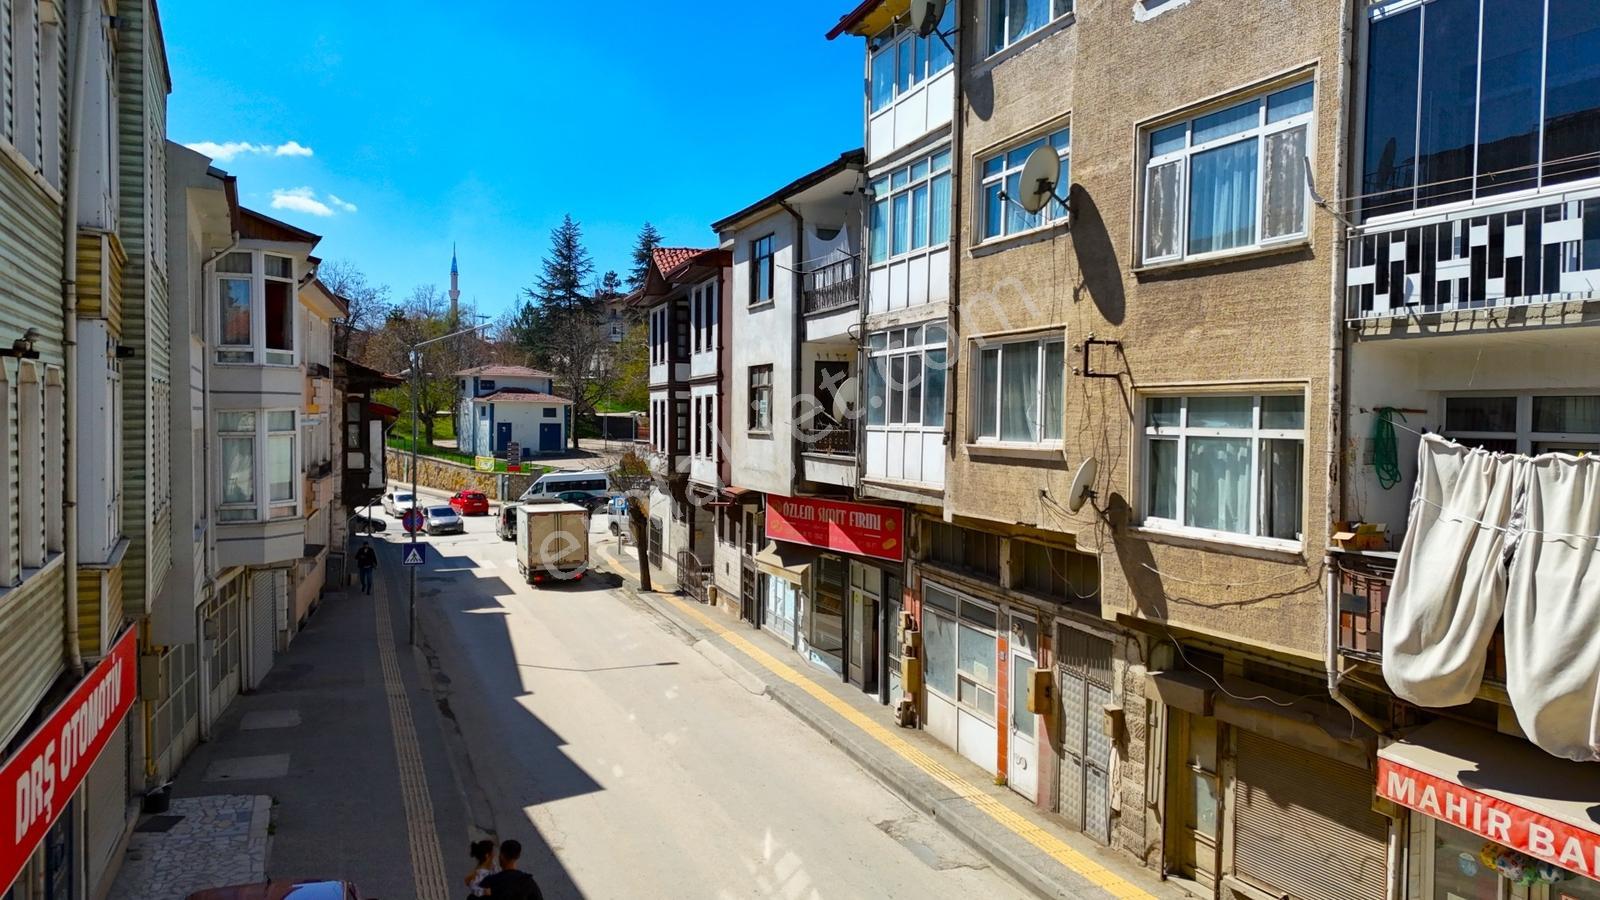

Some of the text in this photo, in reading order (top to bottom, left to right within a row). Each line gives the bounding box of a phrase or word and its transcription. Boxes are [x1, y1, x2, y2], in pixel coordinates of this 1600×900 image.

[782, 502, 815, 521] ÖZLEM
[849, 511, 882, 531] FIRINI
[15, 652, 122, 845] DRŞ OTOMOTİV
[1386, 770, 1600, 877] MAHİR BA
